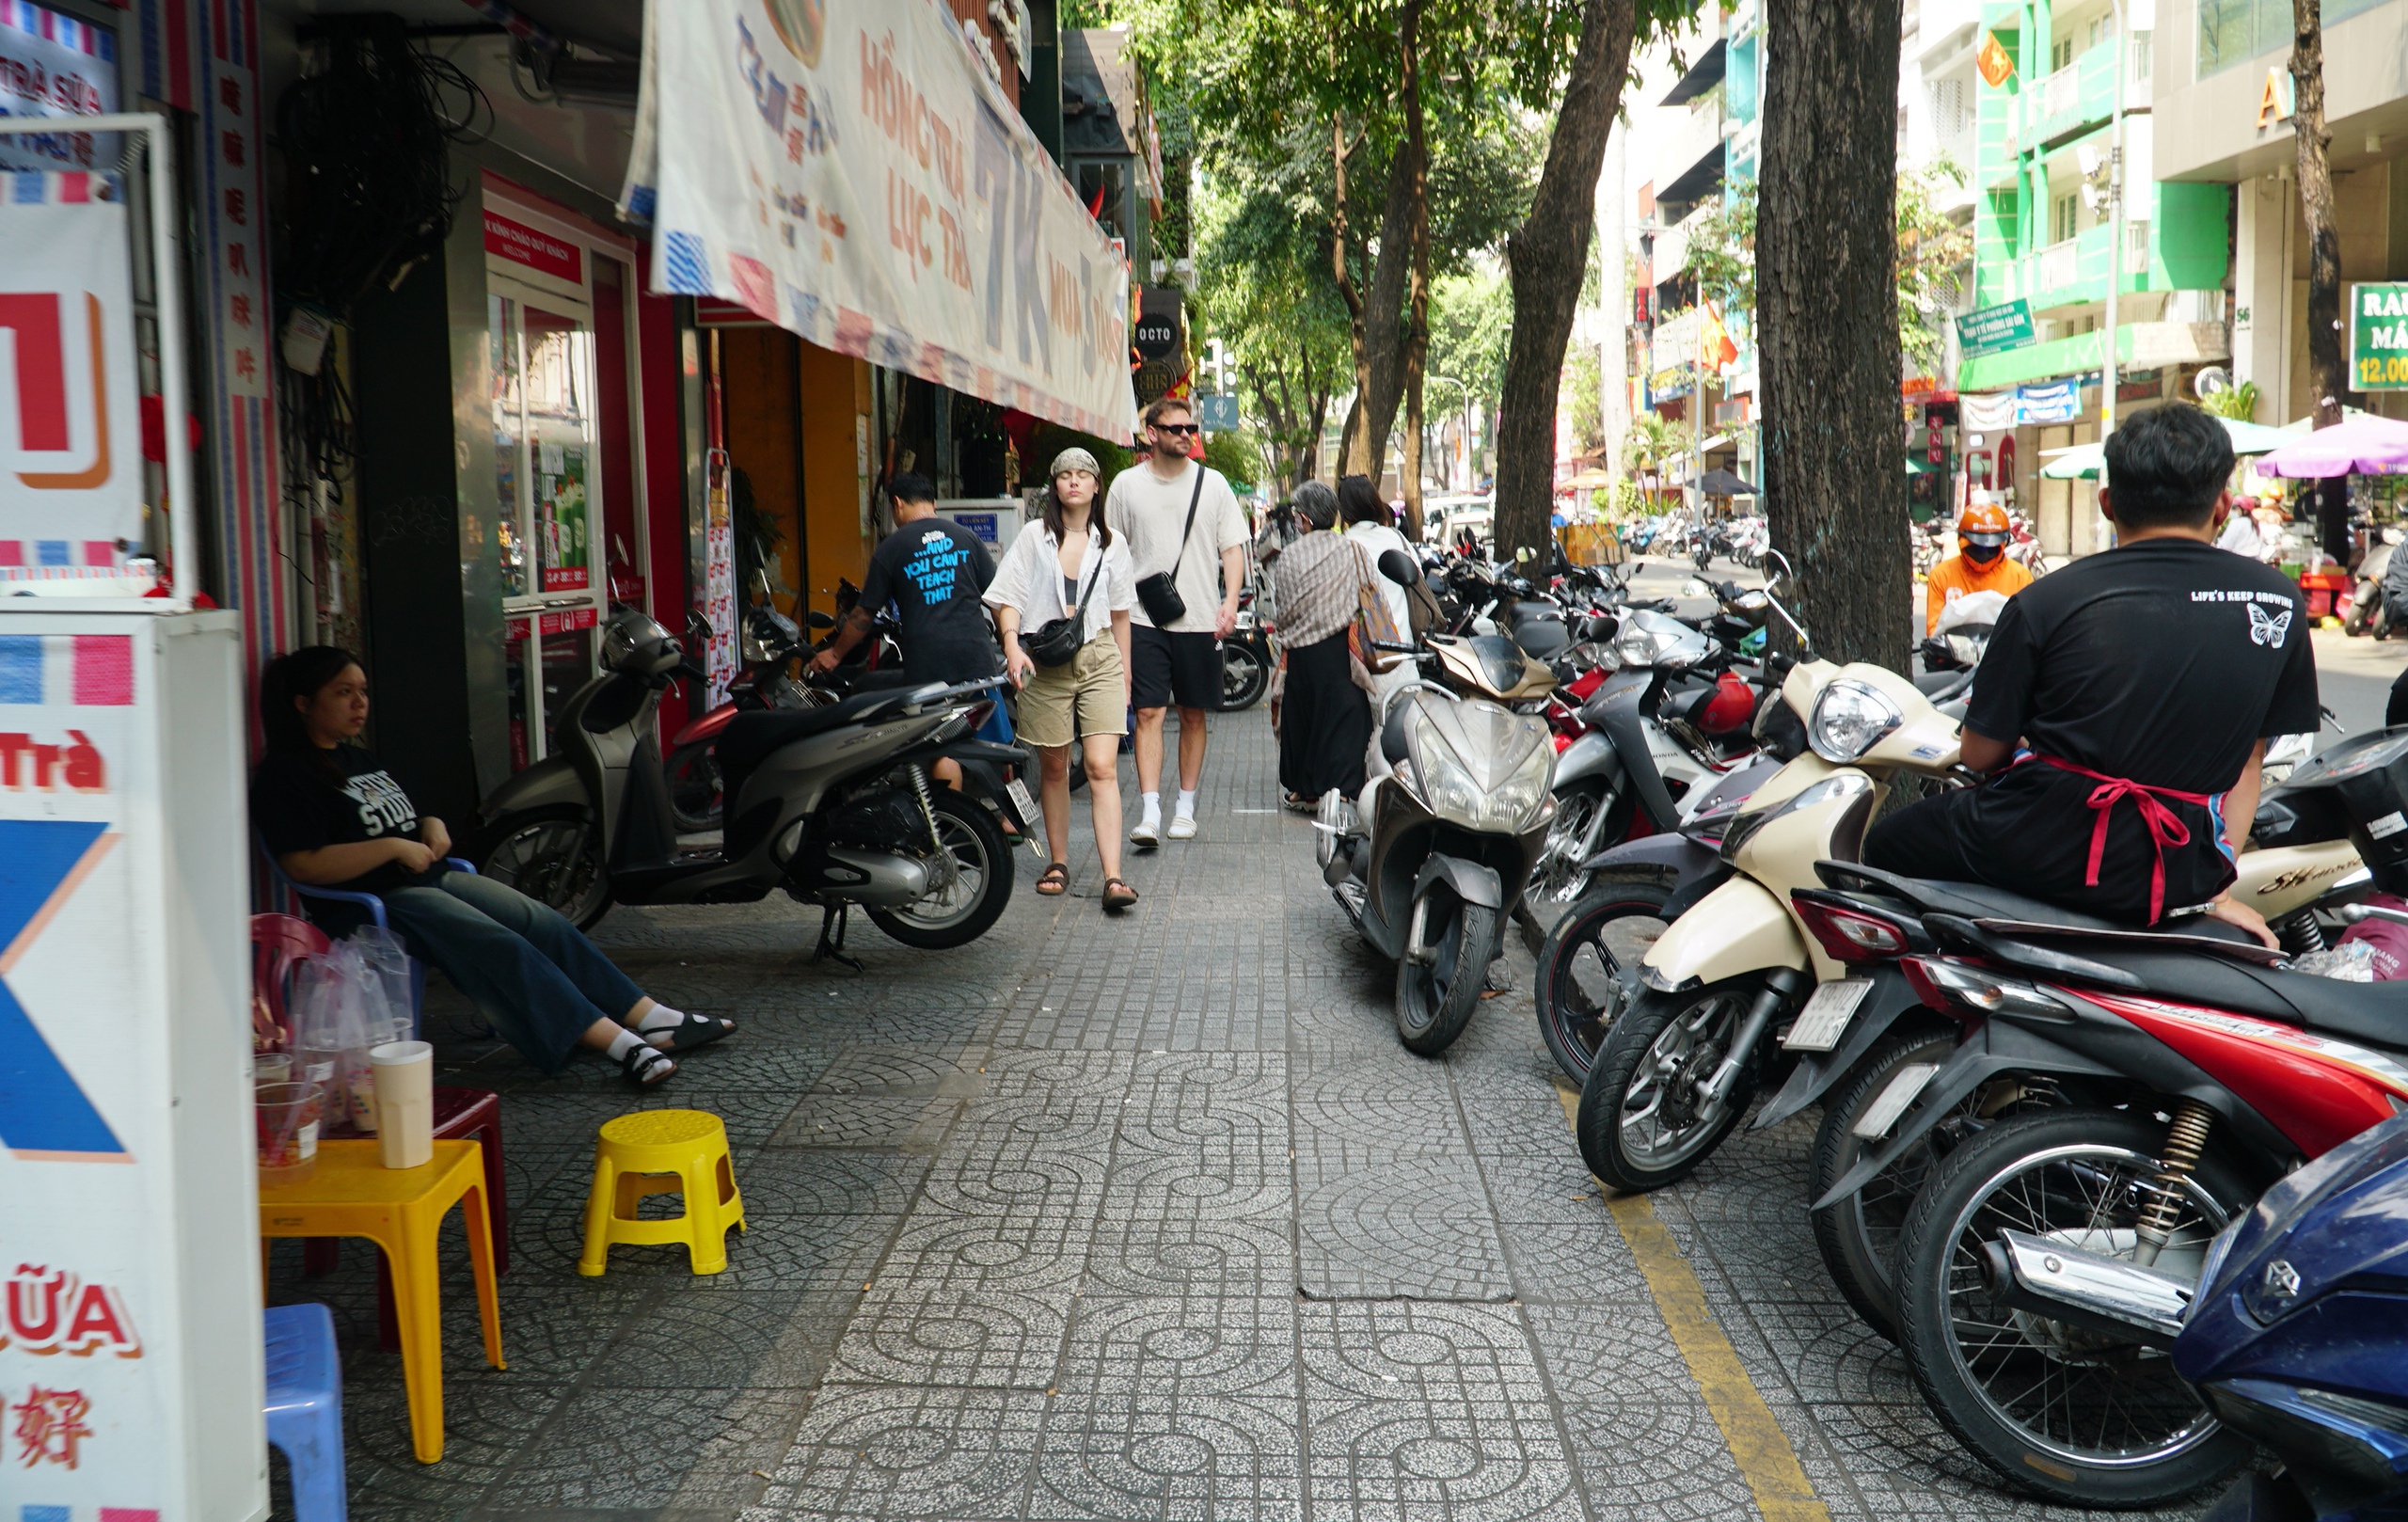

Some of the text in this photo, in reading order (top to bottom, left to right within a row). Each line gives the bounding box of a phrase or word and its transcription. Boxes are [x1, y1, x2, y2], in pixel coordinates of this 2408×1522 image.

[53, 71, 103, 116] SỮA
[2256, 66, 2295, 129] A
[860, 25, 966, 211] HỒNG TRÀ
[887, 165, 976, 298] LỤC TRÀ
[1138, 327, 1171, 341] OCTO
[2237, 308, 2250, 323] 56
[903, 549, 970, 580] YOU CAN'T
[913, 537, 954, 558] ...AND
[916, 568, 956, 590] TEACH
[923, 584, 955, 605] THAT
[2191, 589, 2293, 610] LIFE'S KEEP GROWING
[0, 729, 103, 791] Trà
[0, 1263, 136, 1353] ỮA
[0, 1383, 93, 1469] 好
